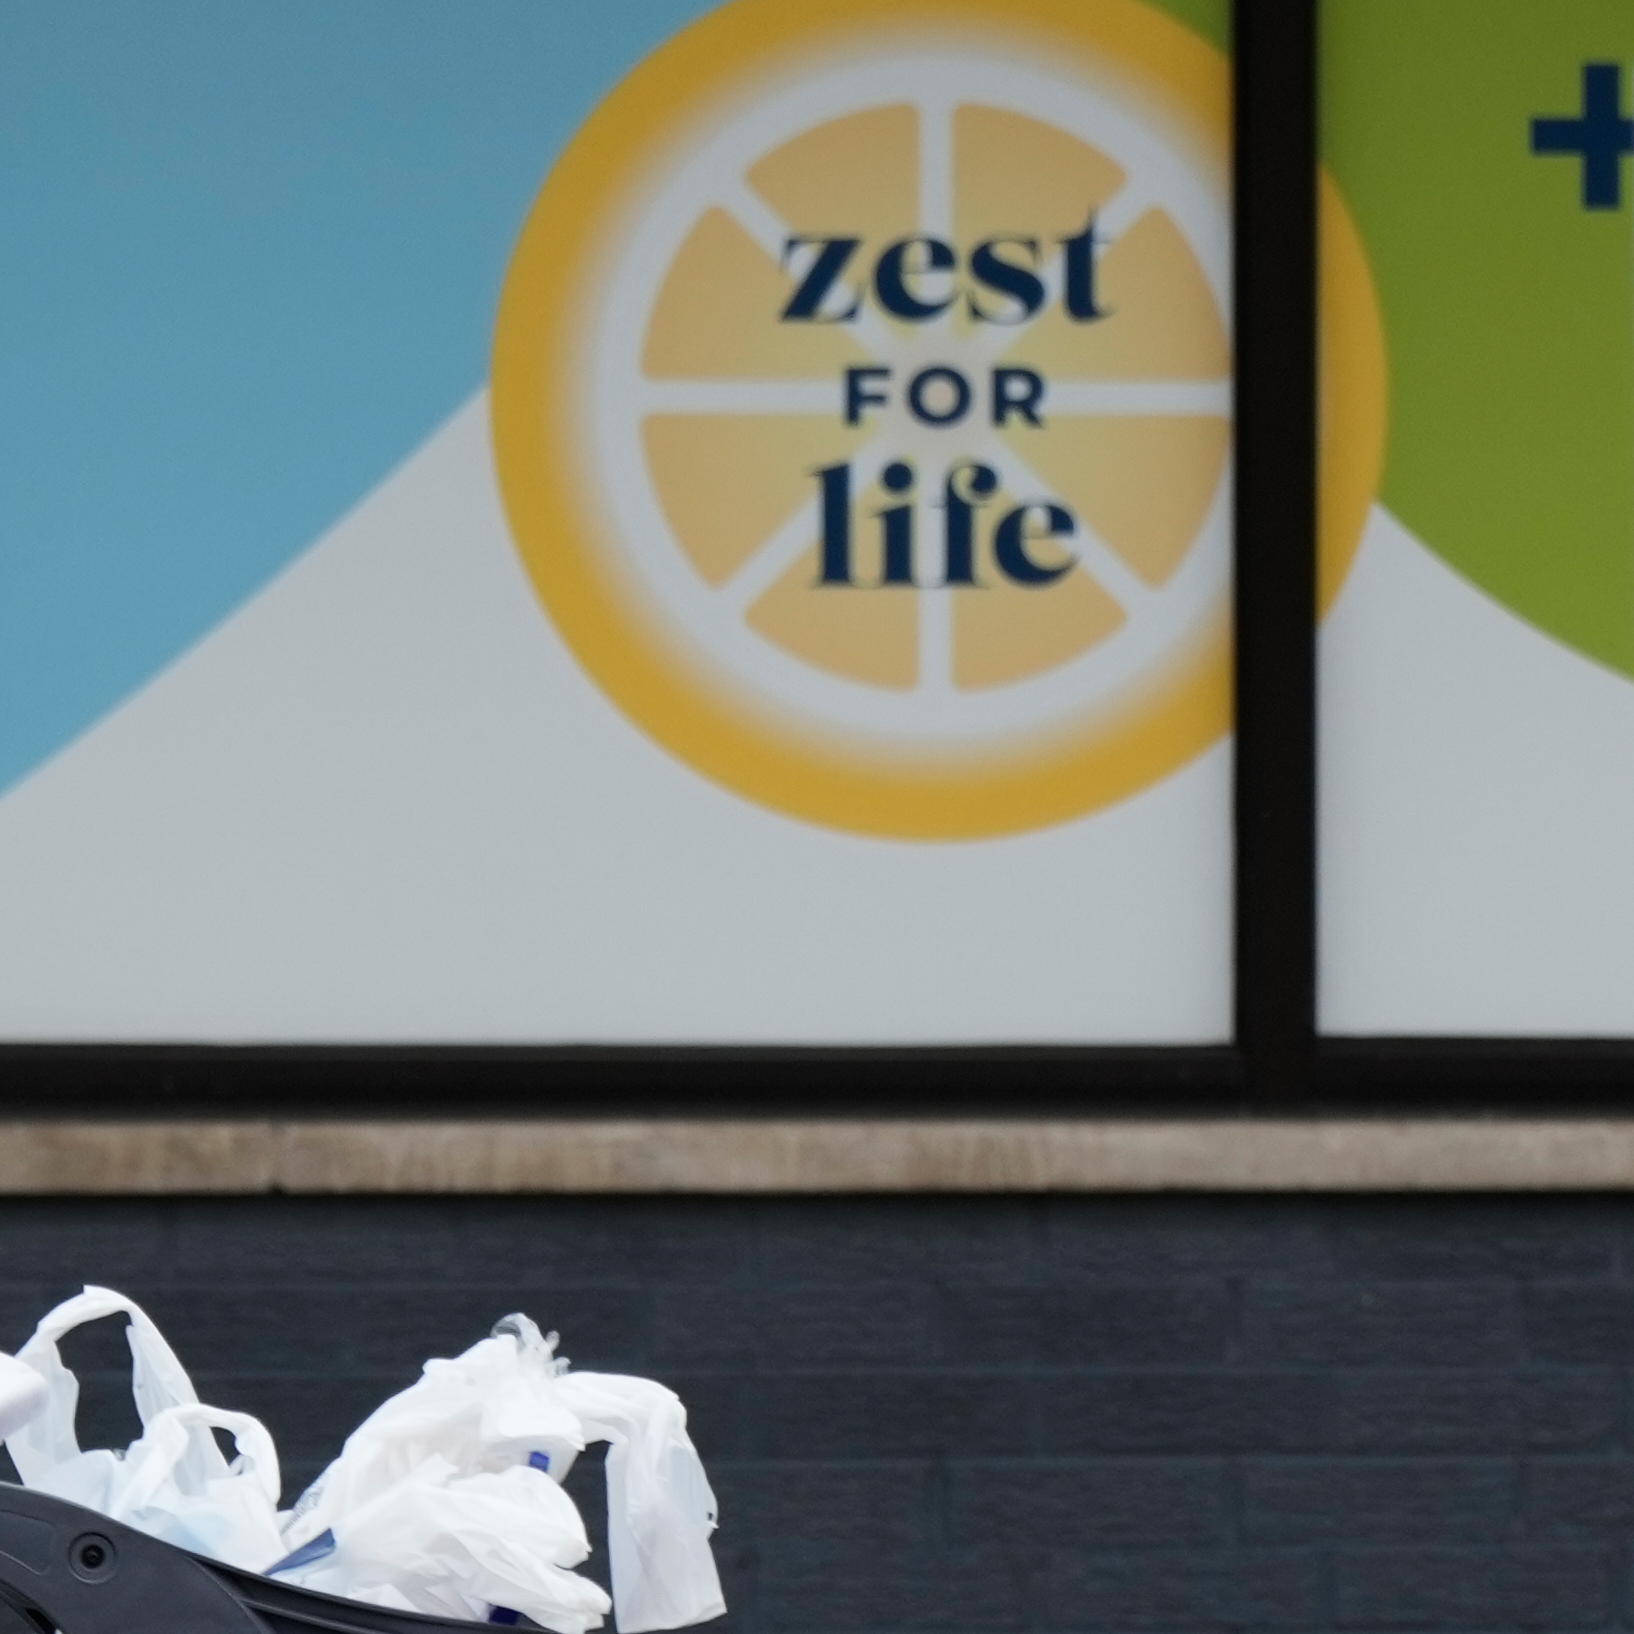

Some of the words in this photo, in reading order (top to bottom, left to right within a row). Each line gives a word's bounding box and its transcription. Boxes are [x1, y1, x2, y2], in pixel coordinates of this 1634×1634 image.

[779, 203, 1117, 326] zest
[843, 364, 1047, 429] FOR
[806, 458, 1081, 591] life
